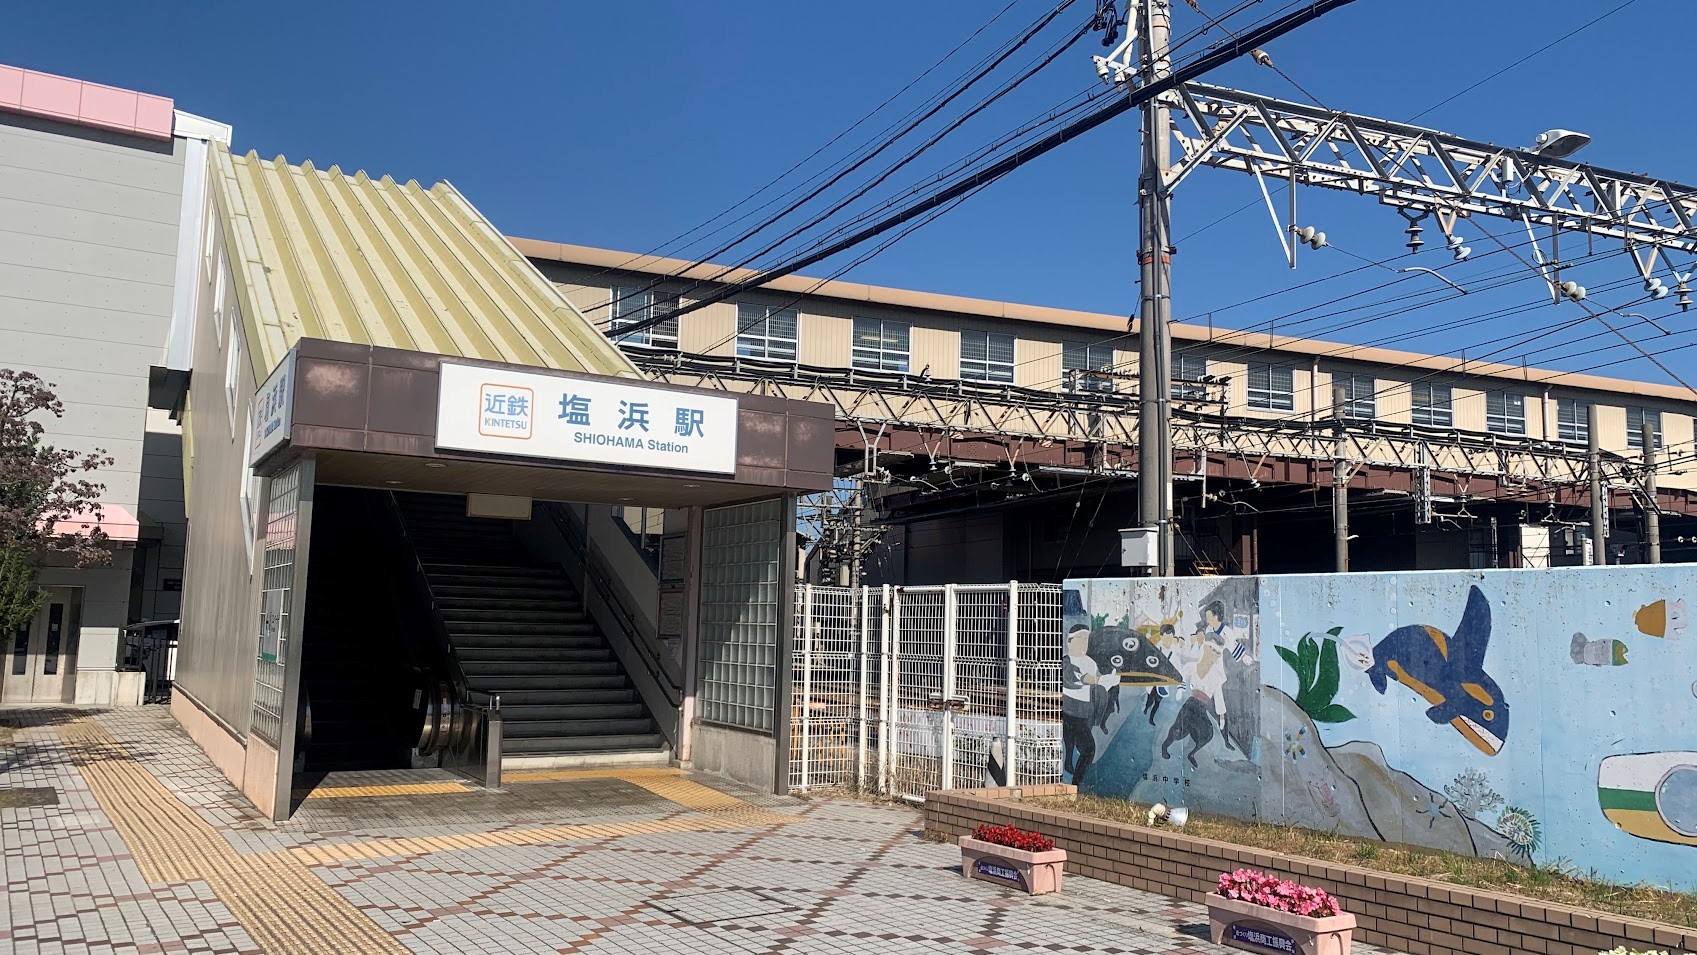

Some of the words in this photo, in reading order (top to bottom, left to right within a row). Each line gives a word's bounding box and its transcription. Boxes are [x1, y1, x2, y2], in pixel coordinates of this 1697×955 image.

[484, 392, 529, 417] 近鉄
[557, 393, 704, 438] 塩浜駅
[484, 417, 527, 430] KINTETSU
[574, 431, 644, 449] SHIOHAMA
[647, 439, 689, 454] Station
